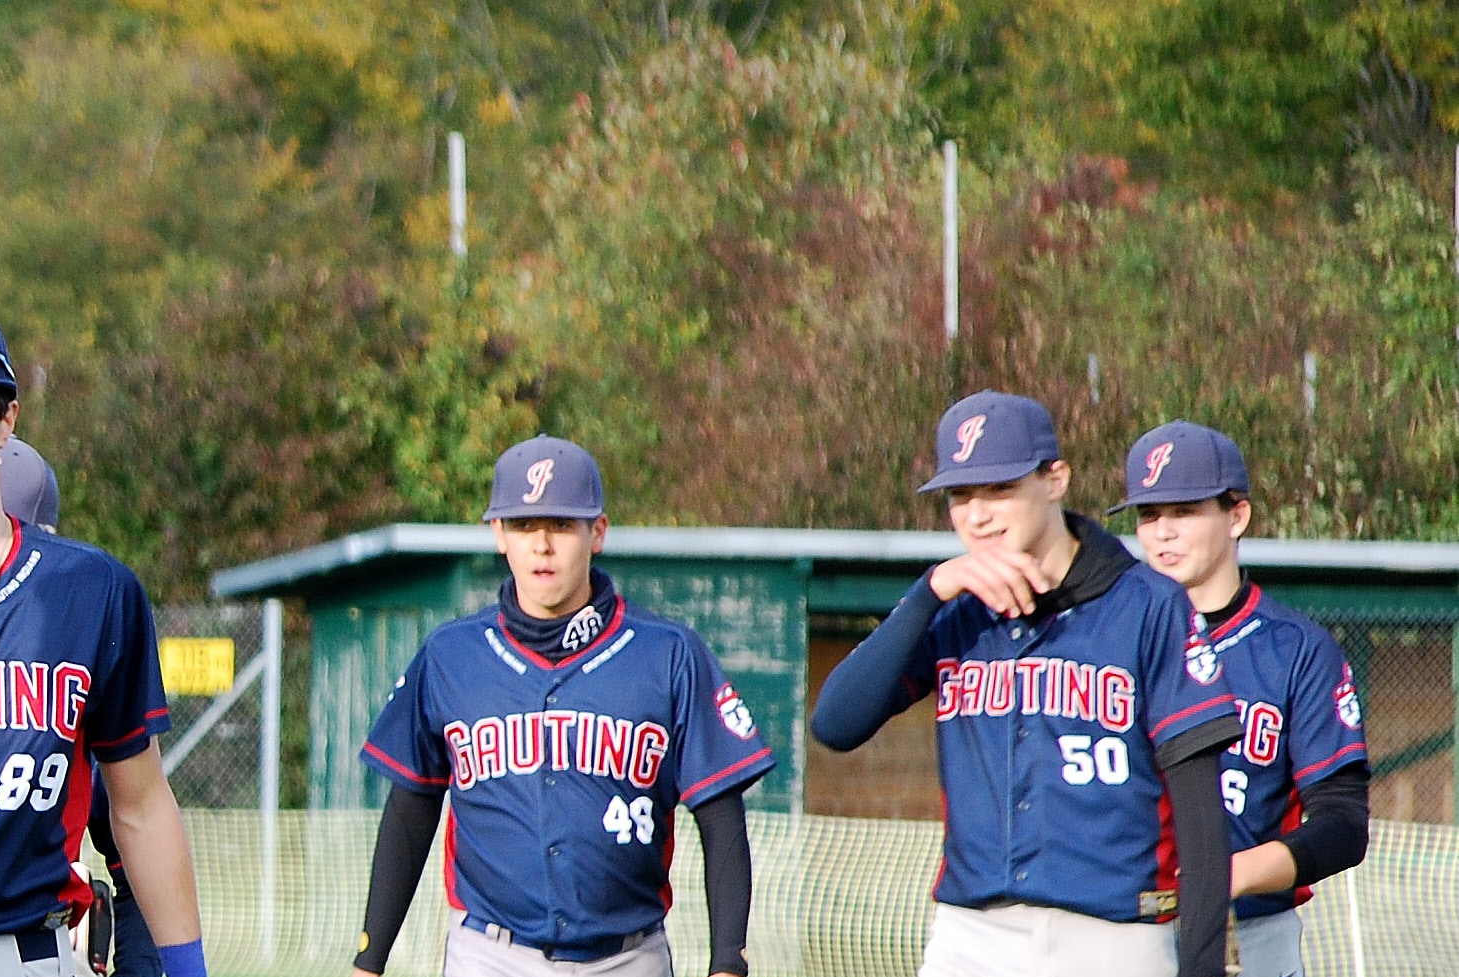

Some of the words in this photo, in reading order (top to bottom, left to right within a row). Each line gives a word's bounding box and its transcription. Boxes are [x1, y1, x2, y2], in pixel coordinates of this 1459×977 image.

[935, 656, 1136, 734] GAUTING
[443, 709, 671, 791] GAUTING
[1057, 734, 1130, 786] 50
